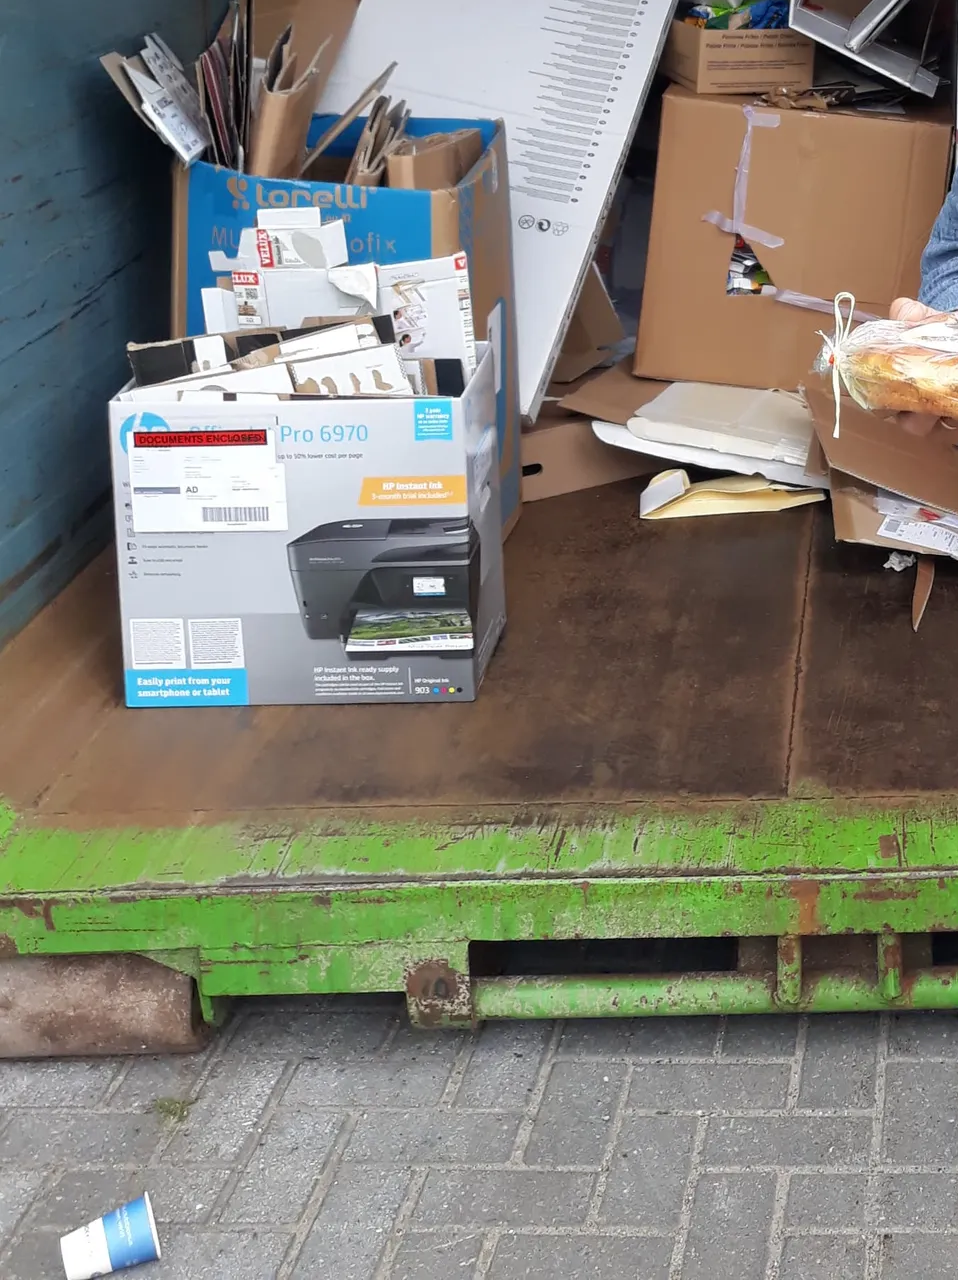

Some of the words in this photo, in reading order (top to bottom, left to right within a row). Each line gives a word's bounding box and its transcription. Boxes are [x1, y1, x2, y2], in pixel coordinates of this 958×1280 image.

[257, 231, 273, 266] VELUX
[280, 425, 313, 443] Pro
[320, 424, 368, 442] 6970
[139, 435, 204, 445] DOCUMENTS
[185, 486, 199, 494] AD
[382, 482, 395, 491] HP
[396, 482, 427, 491] Instant
[429, 481, 443, 490] Ink
[358, 666, 377, 674] ready
[378, 666, 400, 674] supply
[137, 677, 162, 687] Easily
[164, 677, 187, 687] print
[188, 677, 210, 685] from
[211, 677, 232, 686] your
[314, 674, 342, 682] included
[137, 688, 190, 698] smartphone
[192, 689, 201, 697] or
[203, 688, 230, 696] tablet
[414, 686, 430, 695] 903
